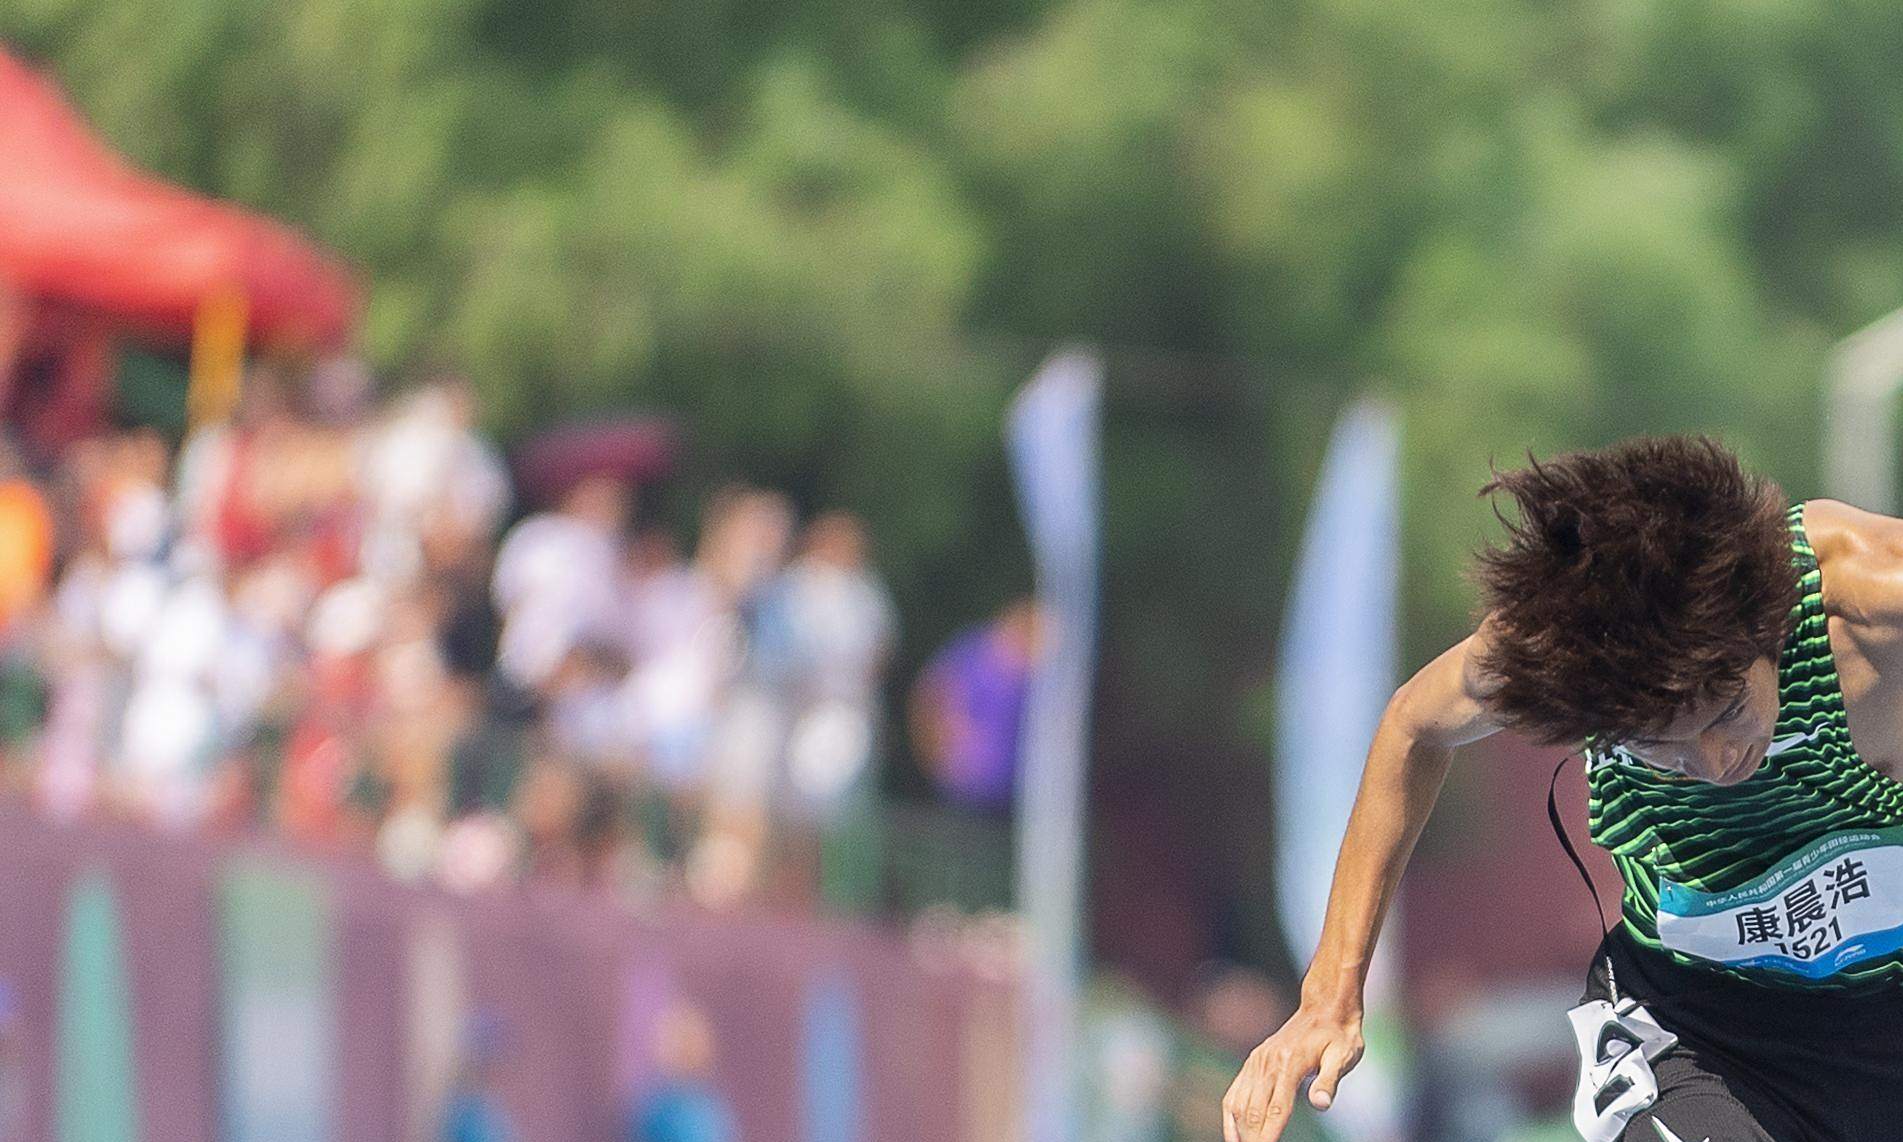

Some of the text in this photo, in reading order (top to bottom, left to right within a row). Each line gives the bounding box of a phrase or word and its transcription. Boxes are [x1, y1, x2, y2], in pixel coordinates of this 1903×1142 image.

[1735, 857, 1871, 945] 康晨浩
[1774, 915, 1842, 960] 1521
